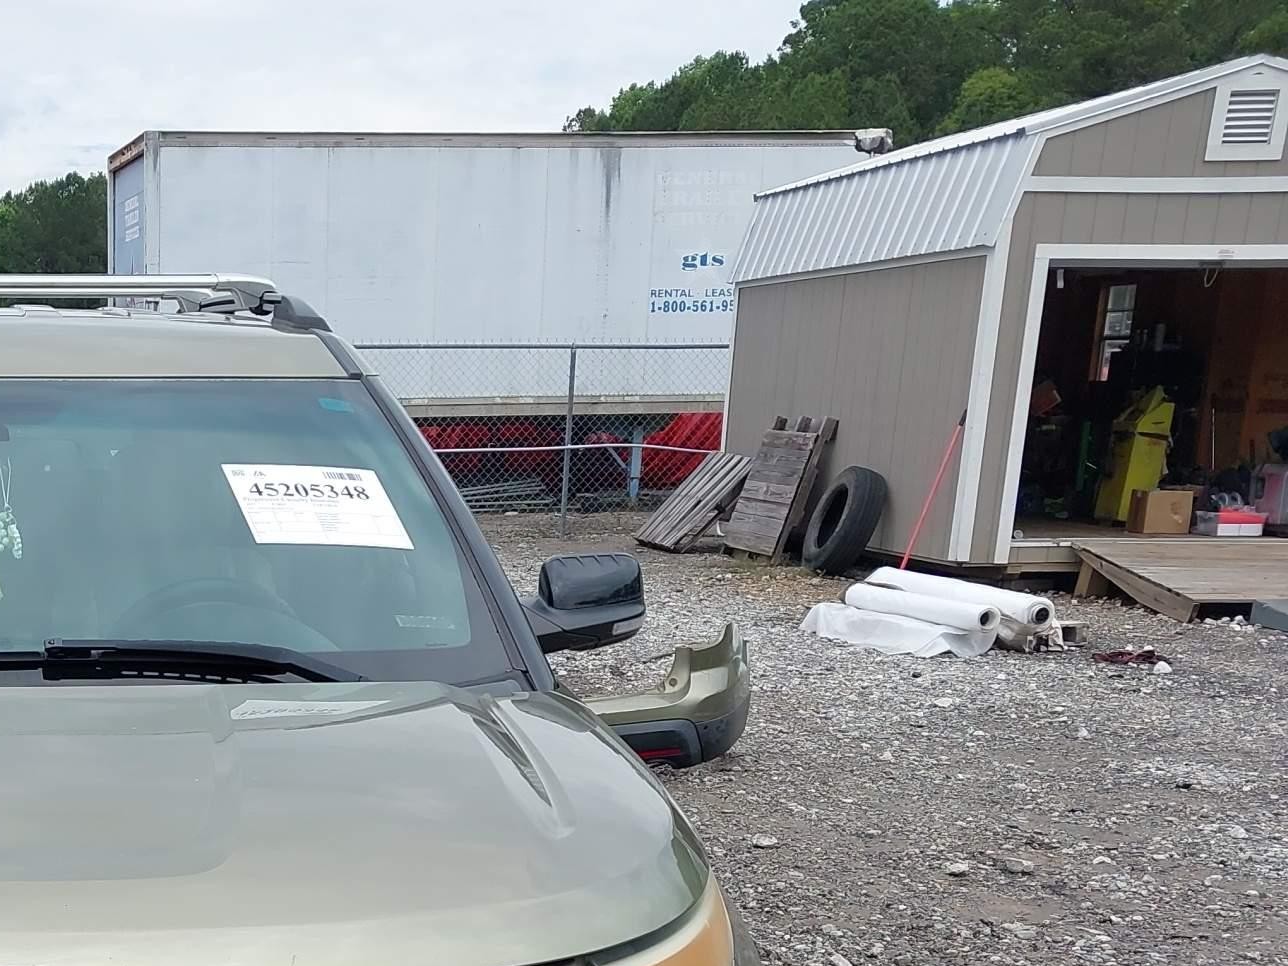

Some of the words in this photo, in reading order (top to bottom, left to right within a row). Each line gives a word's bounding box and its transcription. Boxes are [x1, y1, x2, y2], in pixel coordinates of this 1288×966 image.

[681, 251, 725, 271] gts
[650, 288, 694, 298] RENTAL
[705, 288, 735, 298] LEAS
[249, 482, 370, 501] 45205348
